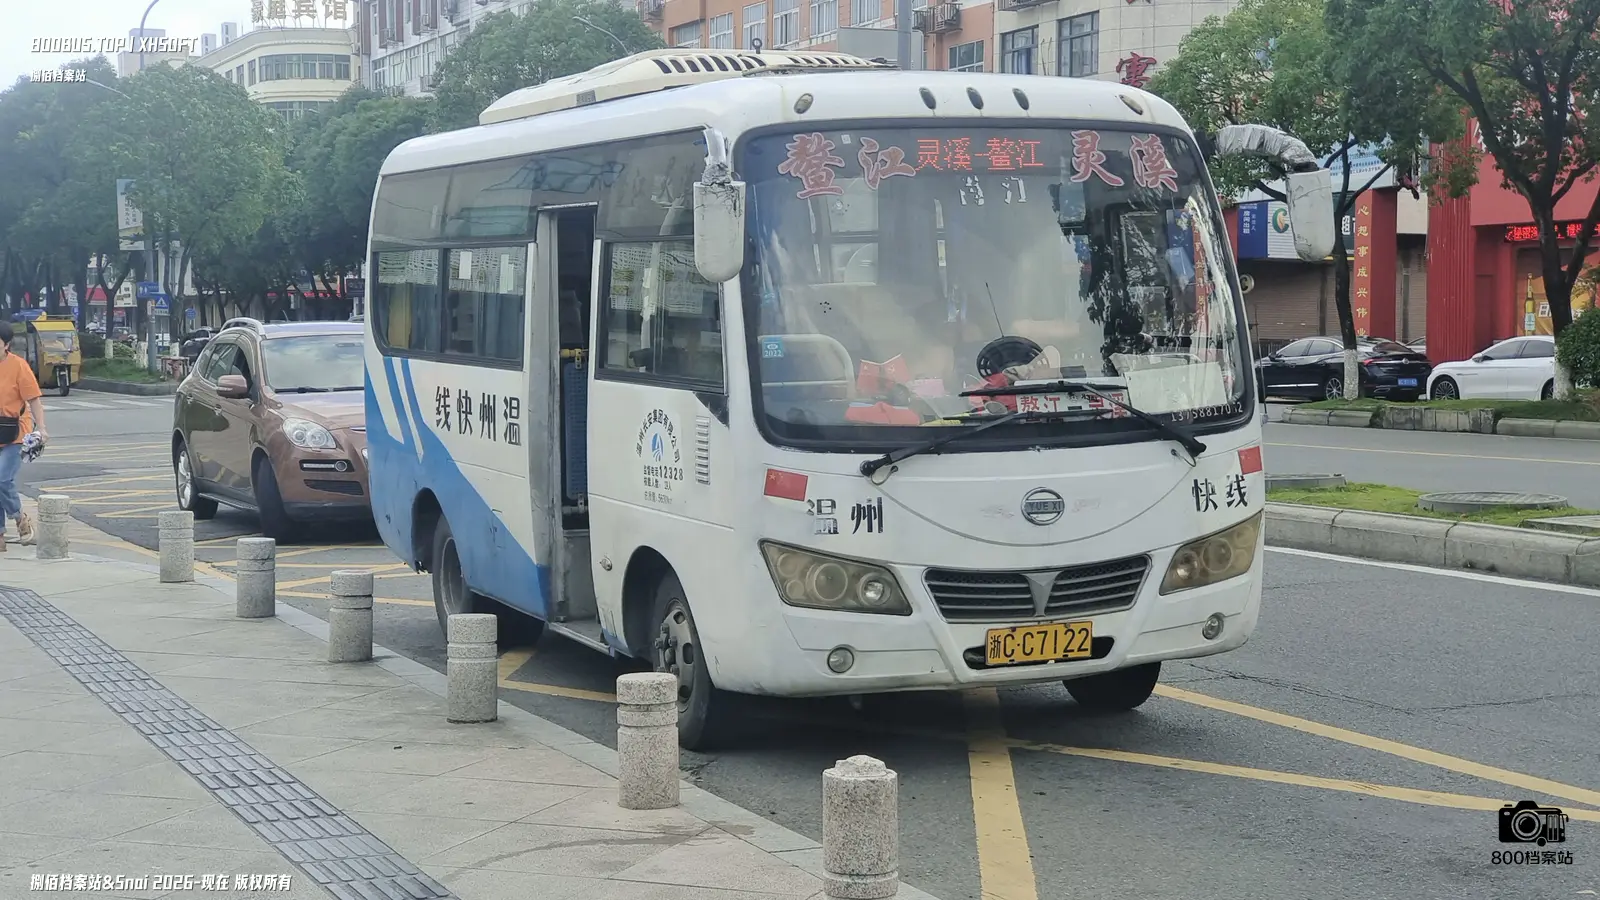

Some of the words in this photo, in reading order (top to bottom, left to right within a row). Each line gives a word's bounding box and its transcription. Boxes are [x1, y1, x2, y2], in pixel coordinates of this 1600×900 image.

[1070, 129, 1178, 192] 灵溪
[764, 350, 782, 358] 2022
[1028, 501, 1050, 511] YUE
[1051, 501, 1062, 511] XI
[1191, 474, 1248, 512] 快线
[806, 496, 884, 535] 温州
